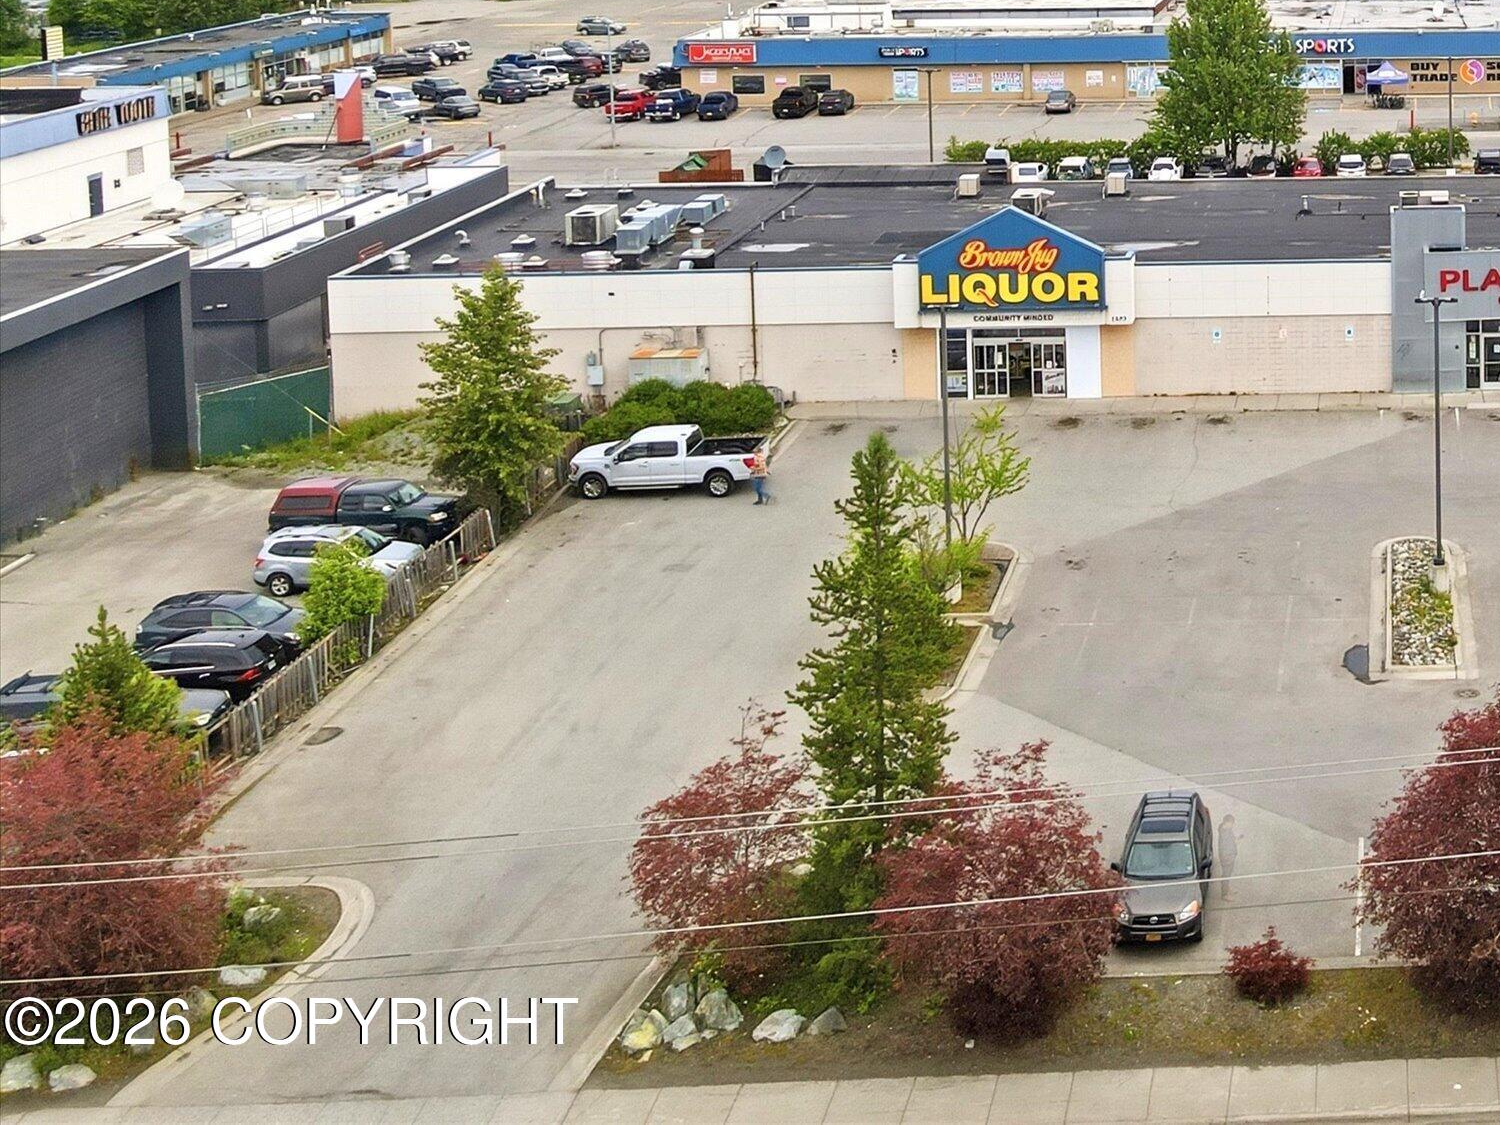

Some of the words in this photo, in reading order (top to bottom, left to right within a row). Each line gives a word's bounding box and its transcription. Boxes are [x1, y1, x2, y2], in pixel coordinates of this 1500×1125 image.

[1295, 38, 1355, 54] SPORTS
[1410, 62, 1440, 71] BUY
[1411, 73, 1458, 82] TRADE
[959, 239, 1026, 270] Brown
[1017, 239, 1060, 274] Jug
[920, 271, 1100, 308] LIQUOR
[973, 314, 1021, 322] COMMUNITY
[1023, 313, 1054, 321] MINDED
